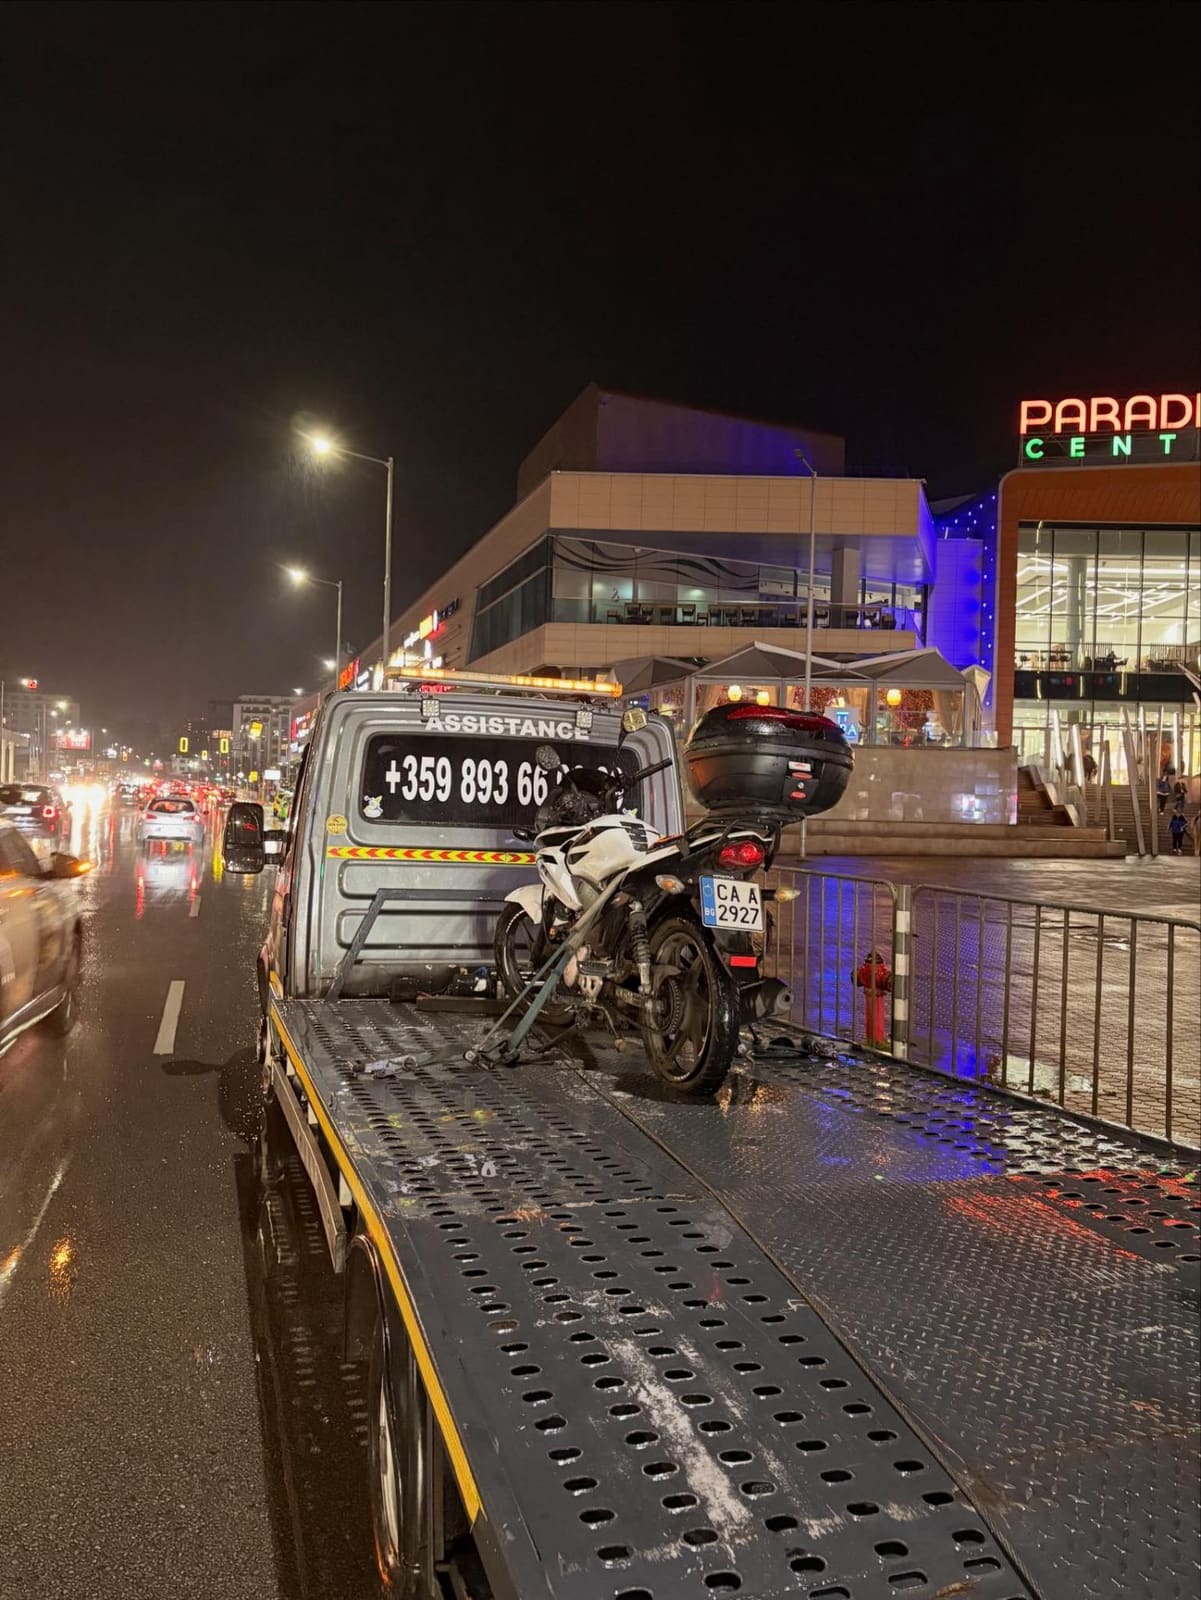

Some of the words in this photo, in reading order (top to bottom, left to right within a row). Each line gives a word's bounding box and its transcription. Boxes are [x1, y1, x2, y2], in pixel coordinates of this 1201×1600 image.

[1025, 434, 1177, 459] CENT
[424, 714, 590, 741] ASSISTANCE
[385, 754, 451, 802] +359
[460, 758, 509, 805] 893
[717, 884, 740, 902] CA
[749, 888, 758, 904] A
[718, 904, 759, 924] 2927
